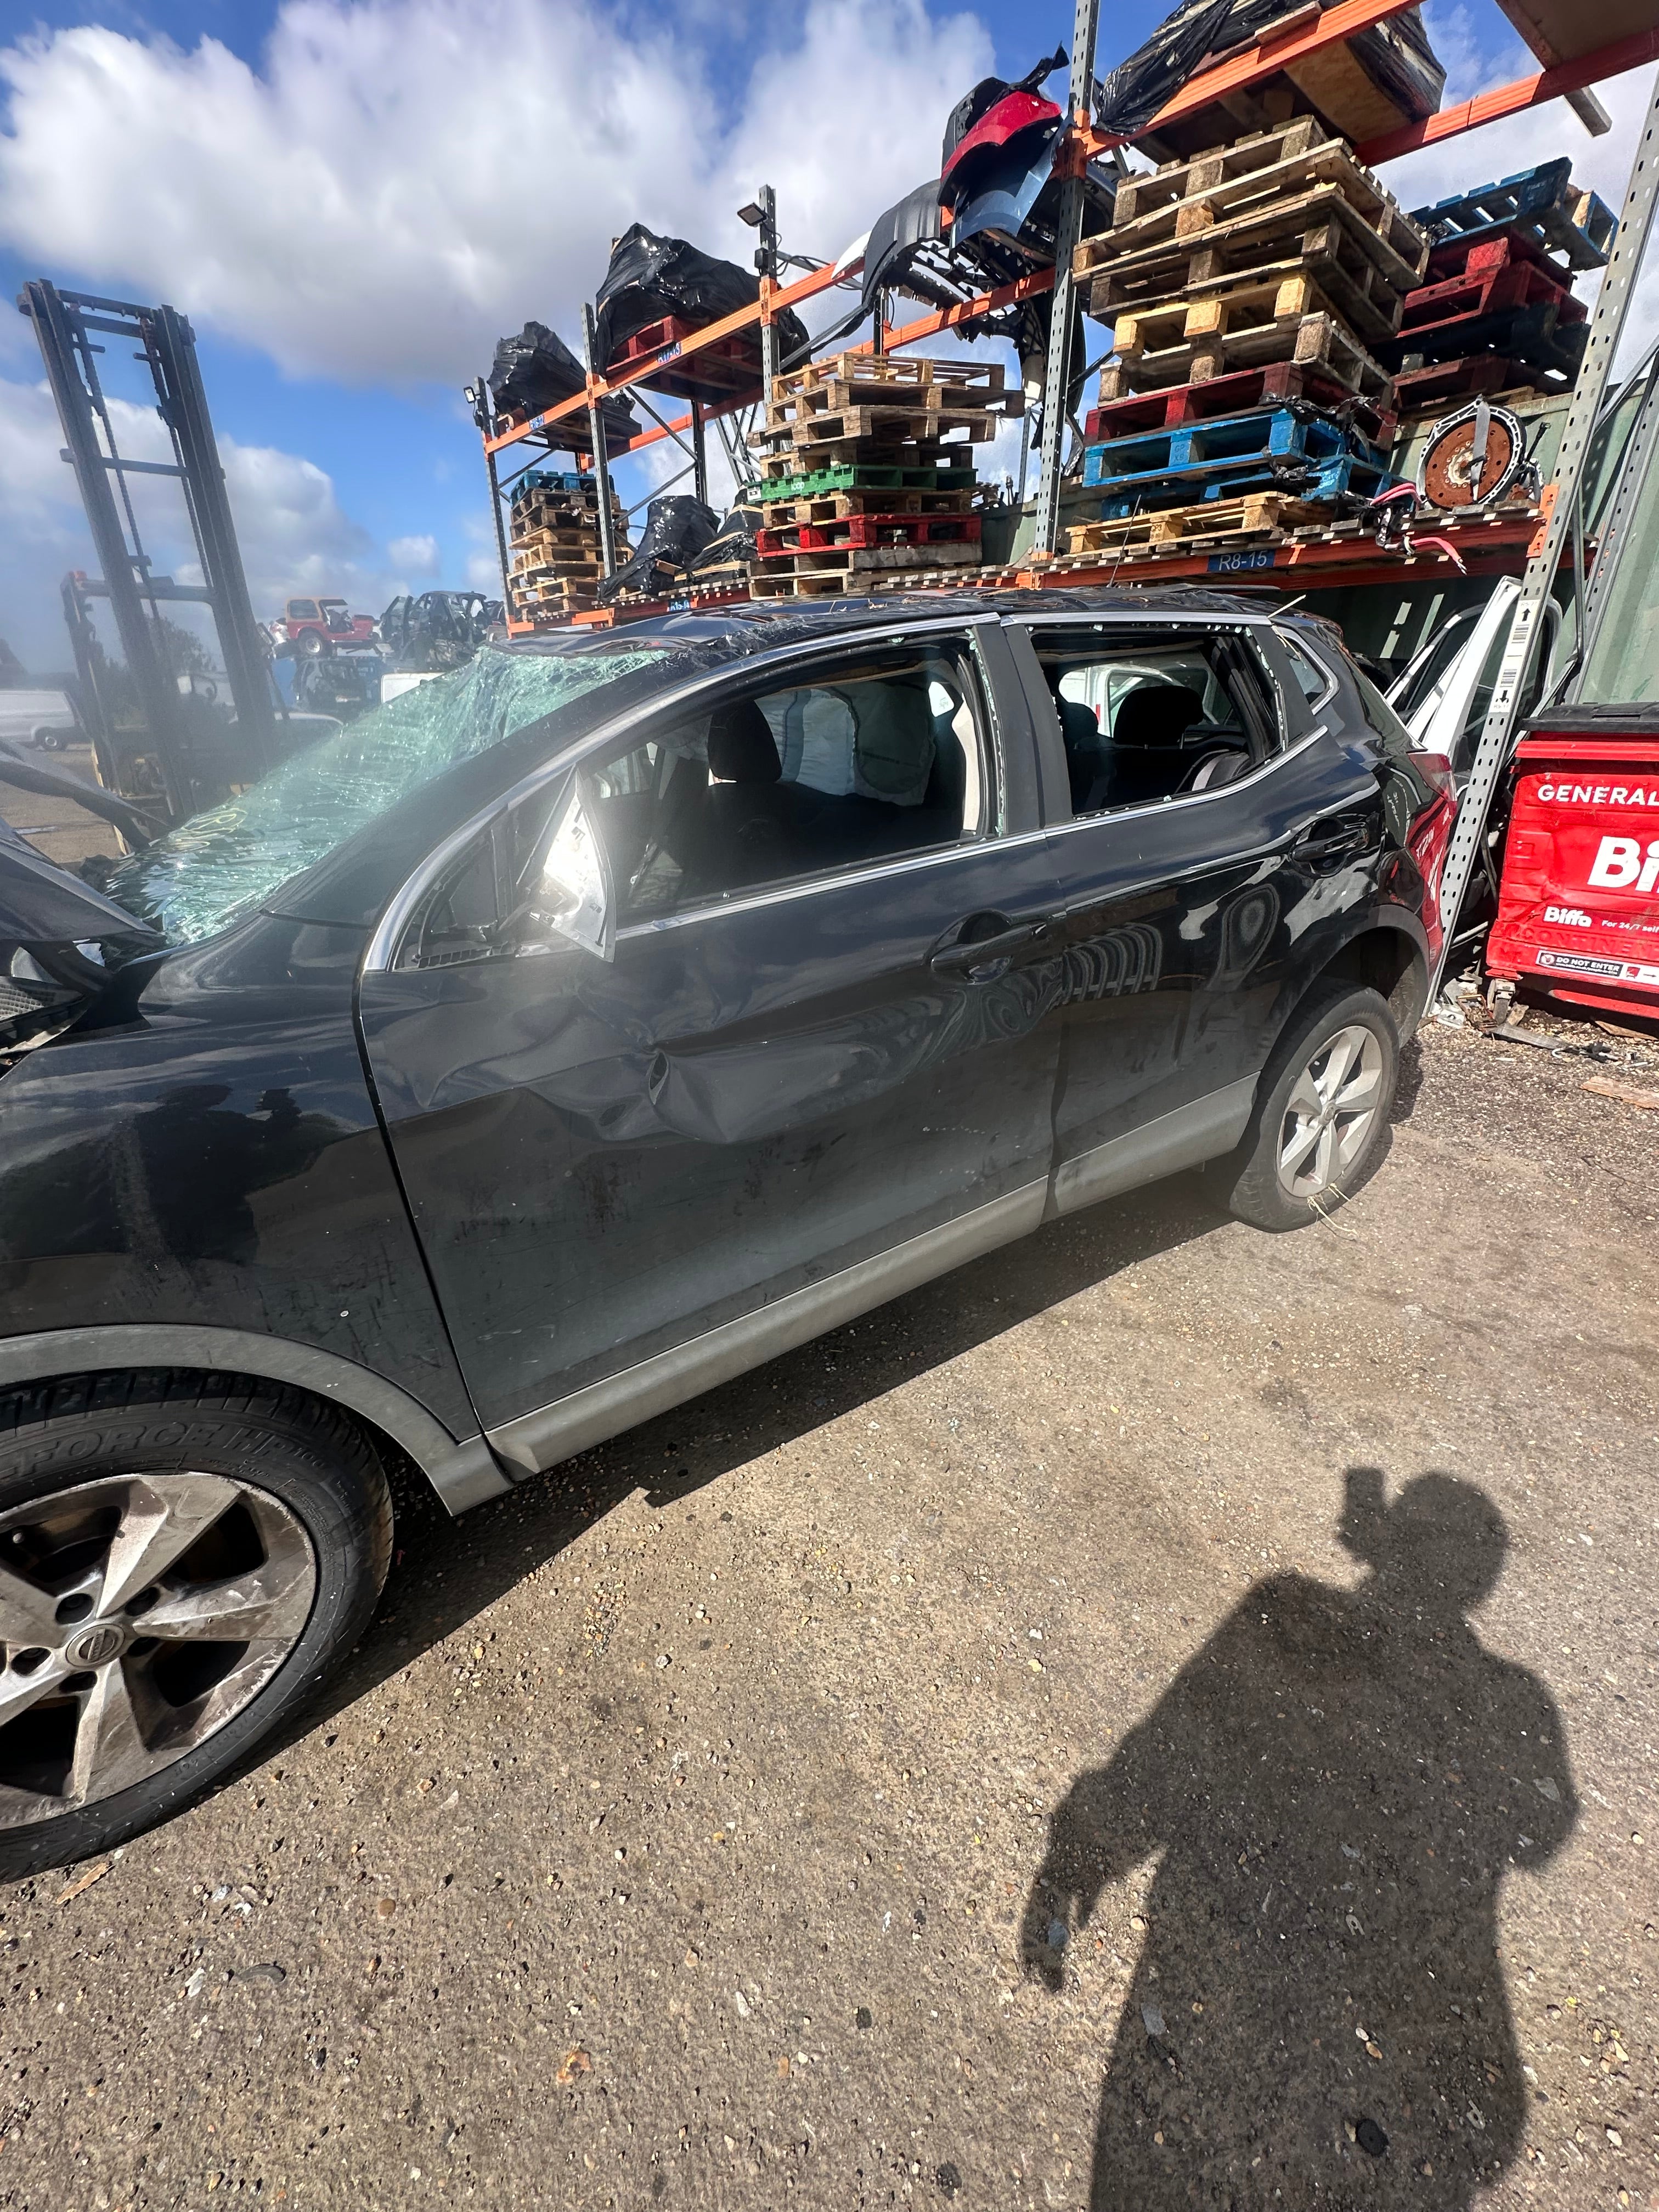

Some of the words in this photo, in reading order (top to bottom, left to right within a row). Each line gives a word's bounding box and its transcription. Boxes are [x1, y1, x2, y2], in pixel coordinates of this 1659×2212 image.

[1219, 550, 1268, 571] R8-15
[1538, 784, 1659, 806] GENERAL
[1587, 836, 1659, 893] Bi
[1544, 906, 1592, 927] Biffa
[1571, 958, 1590, 967] NOT
[1590, 961, 1621, 972] ENTER
